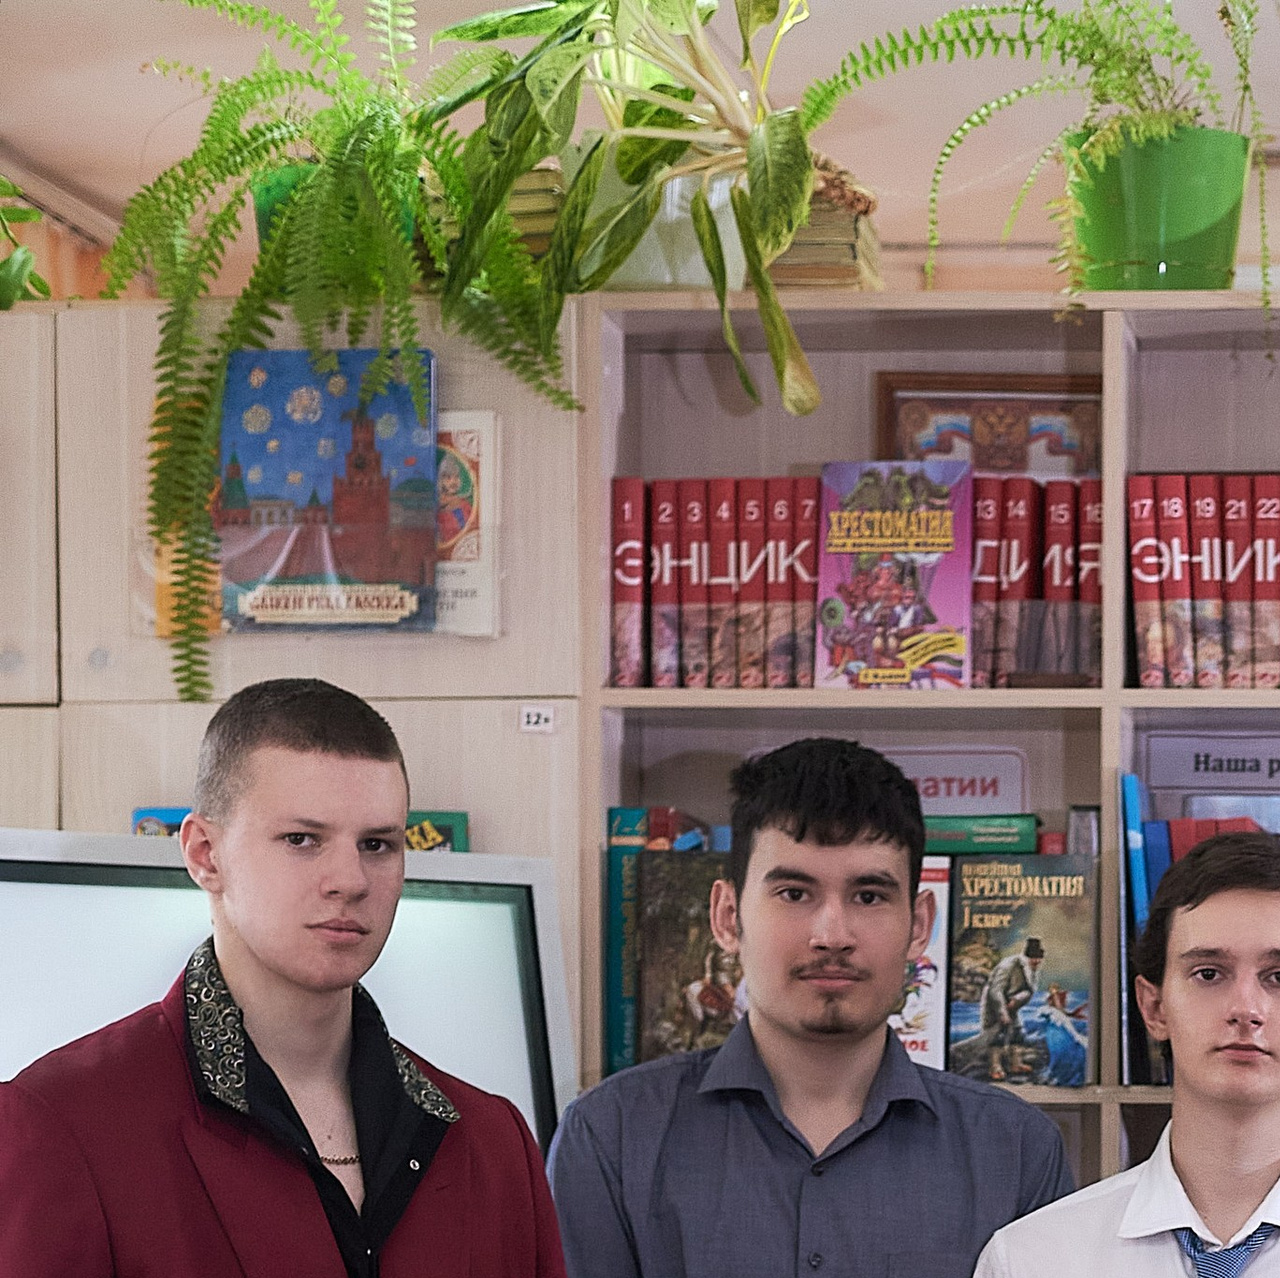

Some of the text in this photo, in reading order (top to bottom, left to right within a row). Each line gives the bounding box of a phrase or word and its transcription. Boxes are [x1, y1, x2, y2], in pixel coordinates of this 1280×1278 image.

[622, 501, 632, 522] 1
[658, 501, 674, 523] 2
[687, 501, 702, 522] 3
[716, 500, 730, 521] 4
[745, 499, 759, 521] 5
[773, 499, 788, 520] 6
[801, 499, 817, 520] 7
[1006, 499, 1026, 519] 14
[1131, 498, 1153, 519] 17
[1161, 496, 1184, 518] 18
[1194, 497, 1216, 518] 19
[1225, 499, 1247, 520] 21
[1194, 753, 1261, 773] Наша
[912, 775, 1000, 798] атии
[962, 876, 1084, 897] ХРЕСТОМАТИЯ
